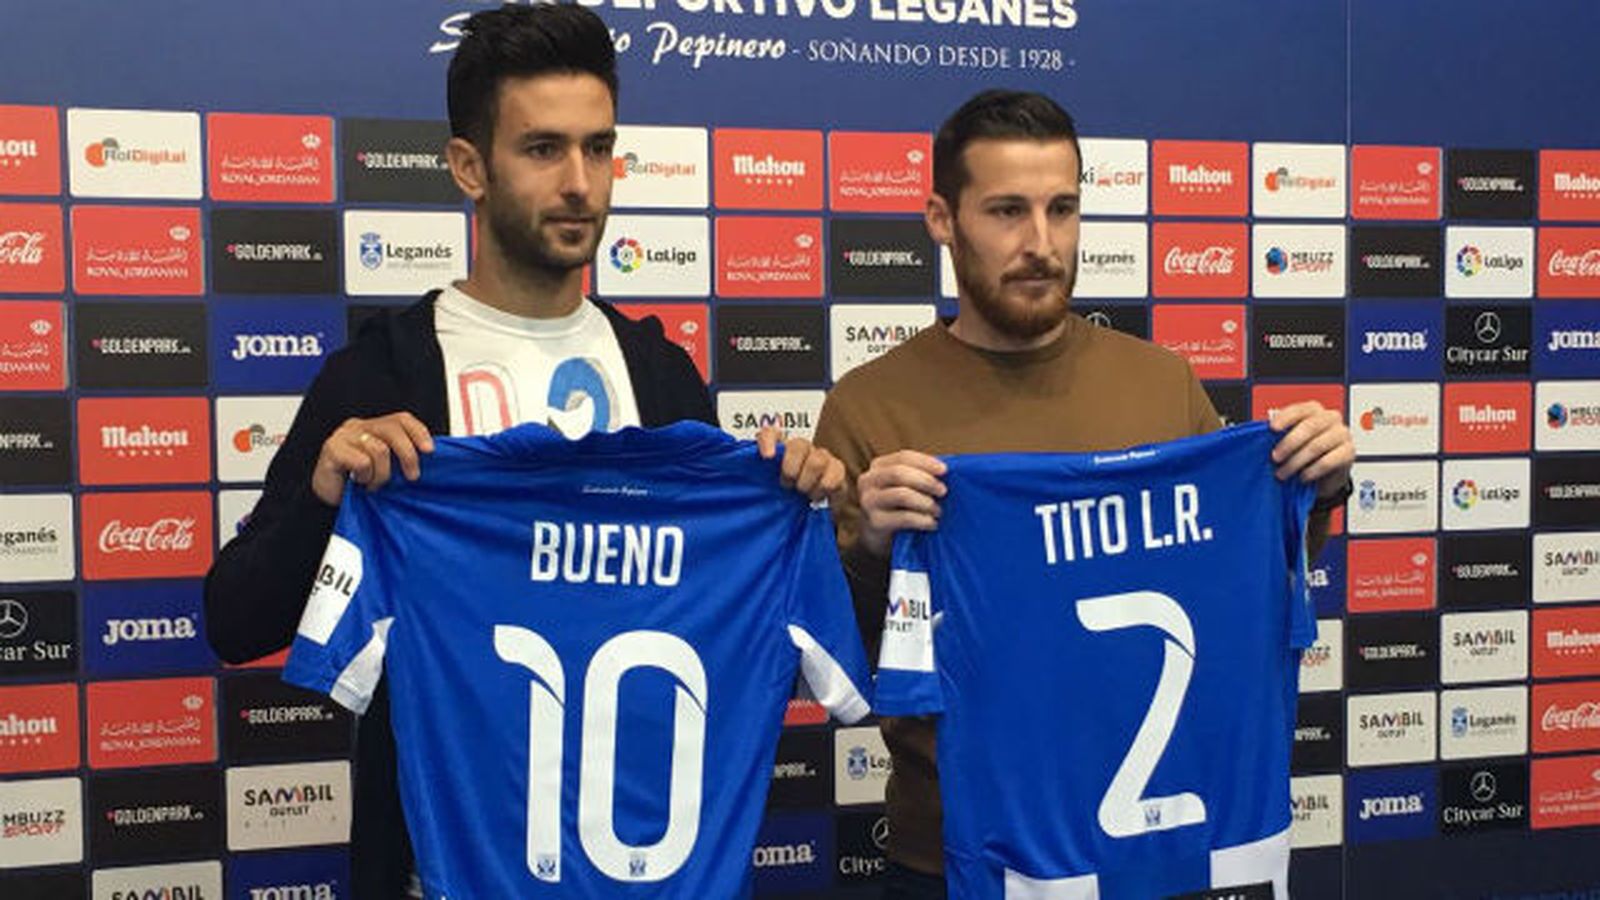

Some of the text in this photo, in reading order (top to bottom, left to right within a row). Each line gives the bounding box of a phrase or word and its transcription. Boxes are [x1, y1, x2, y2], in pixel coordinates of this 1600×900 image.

[647, 22, 786, 68] Pepinero
[808, 38, 931, 66] SOÑANDO
[939, 45, 1010, 69] DESDE
[1019, 49, 1063, 71] 1928
[733, 154, 805, 176] Mahou
[1168, 164, 1232, 185] Mahou
[1554, 173, 1600, 192] Maho
[386, 243, 453, 260] Leganés
[646, 249, 697, 266] LaLiga
[1484, 255, 1523, 271] LaLiga
[1502, 347, 1528, 361] Sur
[1459, 404, 1516, 424] Mahou
[101, 425, 190, 448] Mahou
[1035, 483, 1214, 565] TITO L.R.
[0, 526, 58, 546] eganés
[530, 520, 684, 587] BUENO
[1545, 550, 1600, 567] SAMBI
[33, 640, 72, 661] Sur
[0, 713, 58, 736] ahou
[1076, 590, 1207, 838] 2
[494, 624, 708, 882] 10
[244, 784, 335, 807] SAMBIL
[1500, 802, 1524, 818] Sur
[753, 844, 813, 867] oma
[839, 856, 886, 876] Cityc
